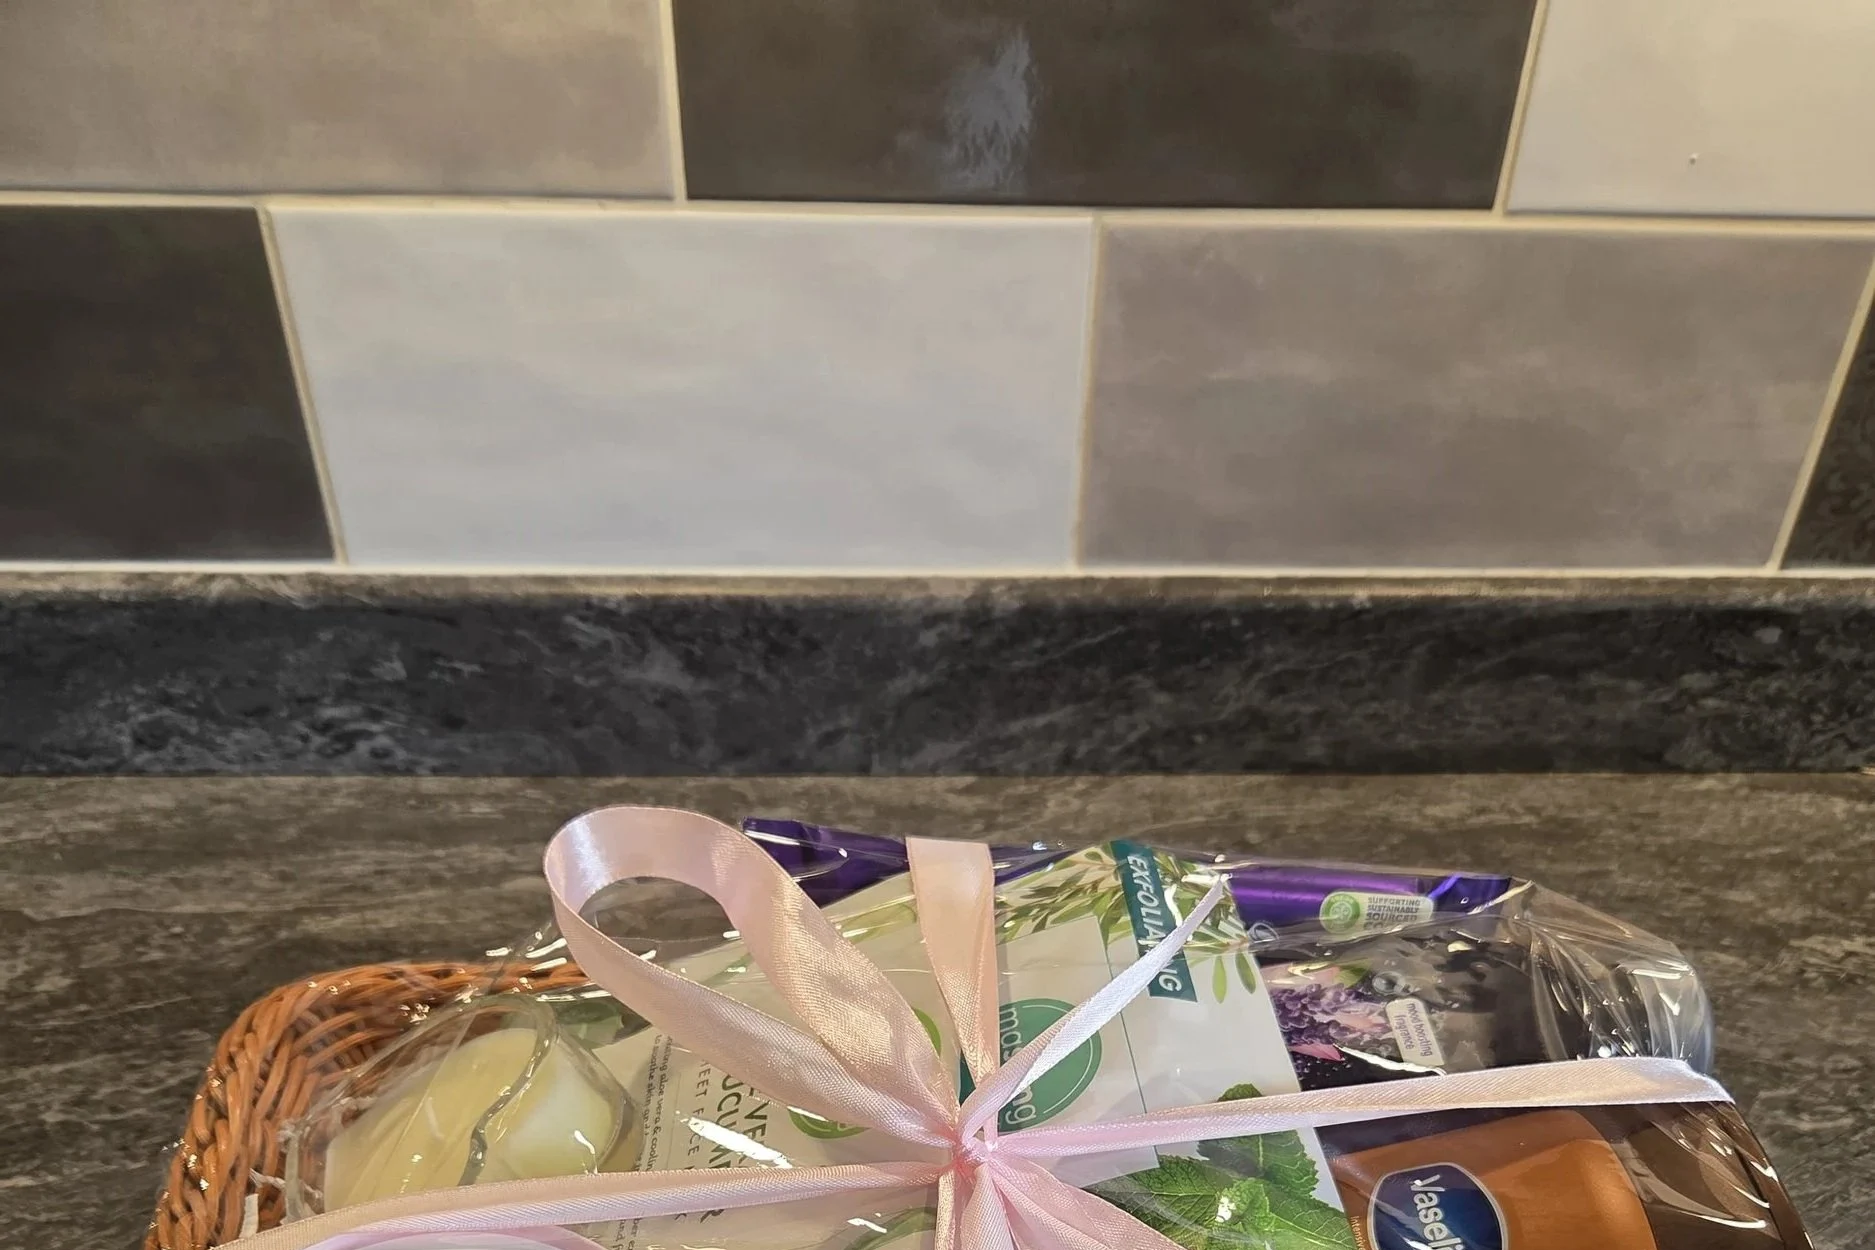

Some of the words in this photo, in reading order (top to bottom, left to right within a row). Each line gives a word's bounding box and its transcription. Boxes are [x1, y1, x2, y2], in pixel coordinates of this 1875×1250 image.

[1368, 896, 1421, 907] SUPPORTING
[1126, 855, 1183, 993] EXFOLIAG
[1394, 1014, 1415, 1050] fragrance
[1416, 1022, 1434, 1058] boosting
[999, 1007, 1037, 1125] masng
